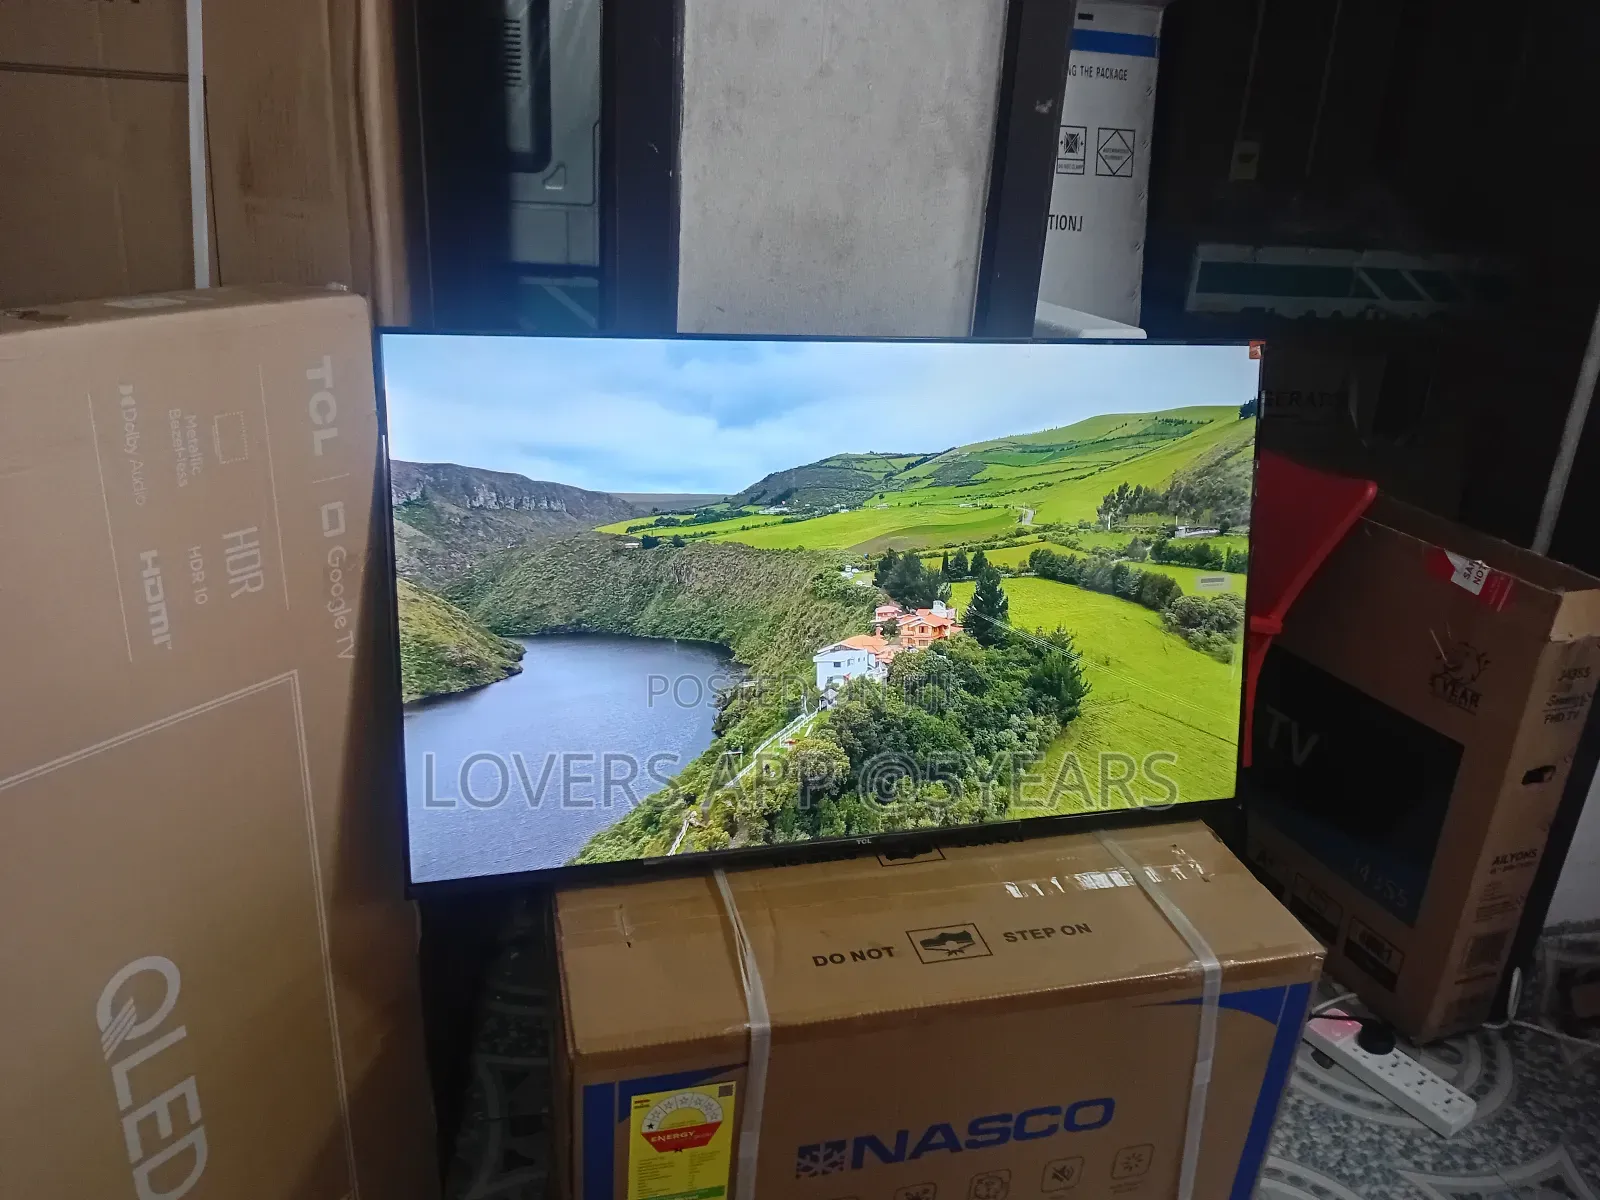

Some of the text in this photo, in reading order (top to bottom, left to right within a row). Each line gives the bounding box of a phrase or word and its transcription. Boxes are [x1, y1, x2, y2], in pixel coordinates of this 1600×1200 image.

[1080, 65, 1093, 78] THE
[1096, 66, 1128, 81] PACKAGE
[306, 354, 338, 457] TCL
[122, 408, 148, 506] Dolby Audio
[184, 414, 204, 476] Metallic
[188, 545, 208, 605] HDR 10
[222, 526, 265, 599] HDR
[327, 546, 356, 660] Google TV
[1265, 703, 1320, 768] TV
[812, 922, 1093, 967] DO NOT STEP ON
[96, 955, 208, 1200] QLED
[650, 1130, 697, 1142] ENERGY
[851, 1097, 1116, 1170] NASCO
